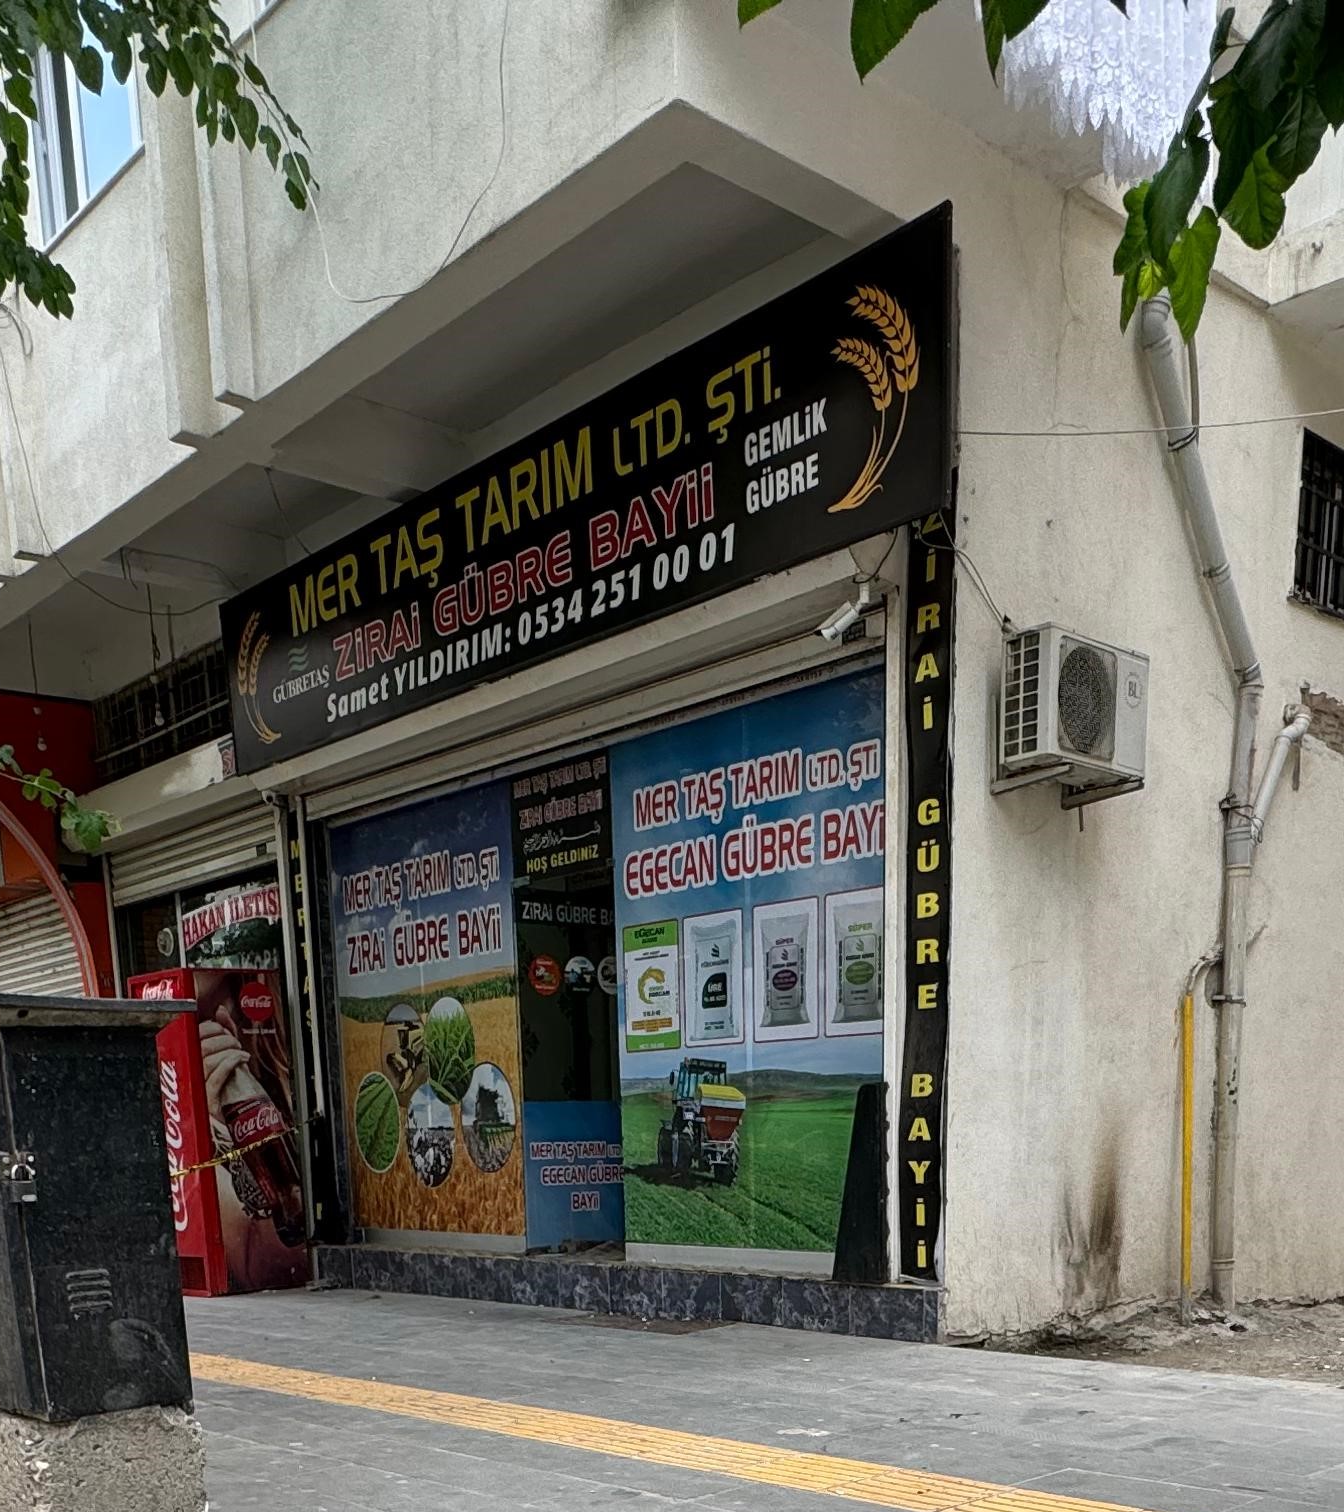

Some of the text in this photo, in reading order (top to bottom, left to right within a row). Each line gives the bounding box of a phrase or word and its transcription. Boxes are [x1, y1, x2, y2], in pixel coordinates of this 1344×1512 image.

[744, 397, 828, 467] GEMLİK
[745, 452, 819, 515] GÜBRE
[289, 553, 358, 638] MER
[371, 509, 445, 589] TAŞ
[456, 426, 593, 553] TARIM
[613, 399, 690, 476] LTD.
[433, 531, 574, 637] GÜBRE
[325, 522, 736, 723] Samet YILDIRIM: 0534 251 00 01
[272, 664, 330, 704] GÜBRETAŞ
[634, 785, 677, 831] MER
[682, 777, 725, 823] TAŞ
[730, 749, 802, 804] TARIM
[343, 871, 373, 914] MER
[374, 861, 403, 912] TAŞ
[404, 850, 452, 900] TARIM
[526, 857, 548, 874] HOŞ
[625, 838, 716, 900] EGECAN
[722, 815, 814, 880] GÜBRE
[183, 902, 226, 948] HAKAN
[556, 902, 597, 924] GÜBRE
[916, 798, 941, 1010] GÜBRE
[392, 911, 450, 968] GÜBRE
[530, 1142, 554, 1160] MER
[554, 1142, 575, 1162] TAŞ
[576, 1141, 606, 1159] TARIM
[541, 1165, 586, 1185] EGECAN
